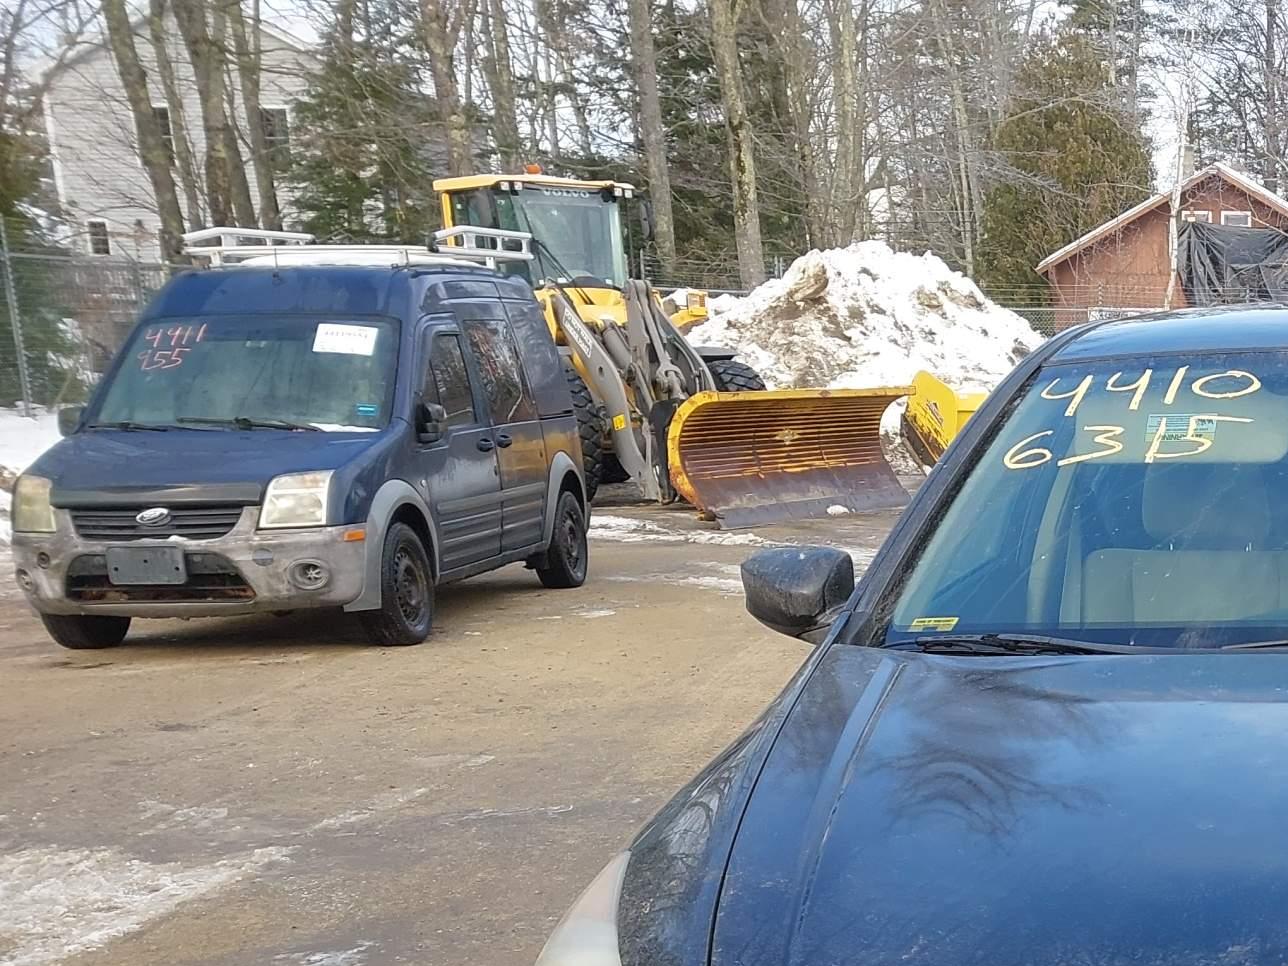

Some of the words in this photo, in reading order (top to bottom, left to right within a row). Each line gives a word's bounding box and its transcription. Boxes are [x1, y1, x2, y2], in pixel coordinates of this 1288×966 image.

[543, 188, 590, 198] VOLVO
[1040, 365, 1262, 416] 4410
[1003, 413, 1255, 470] 6315
